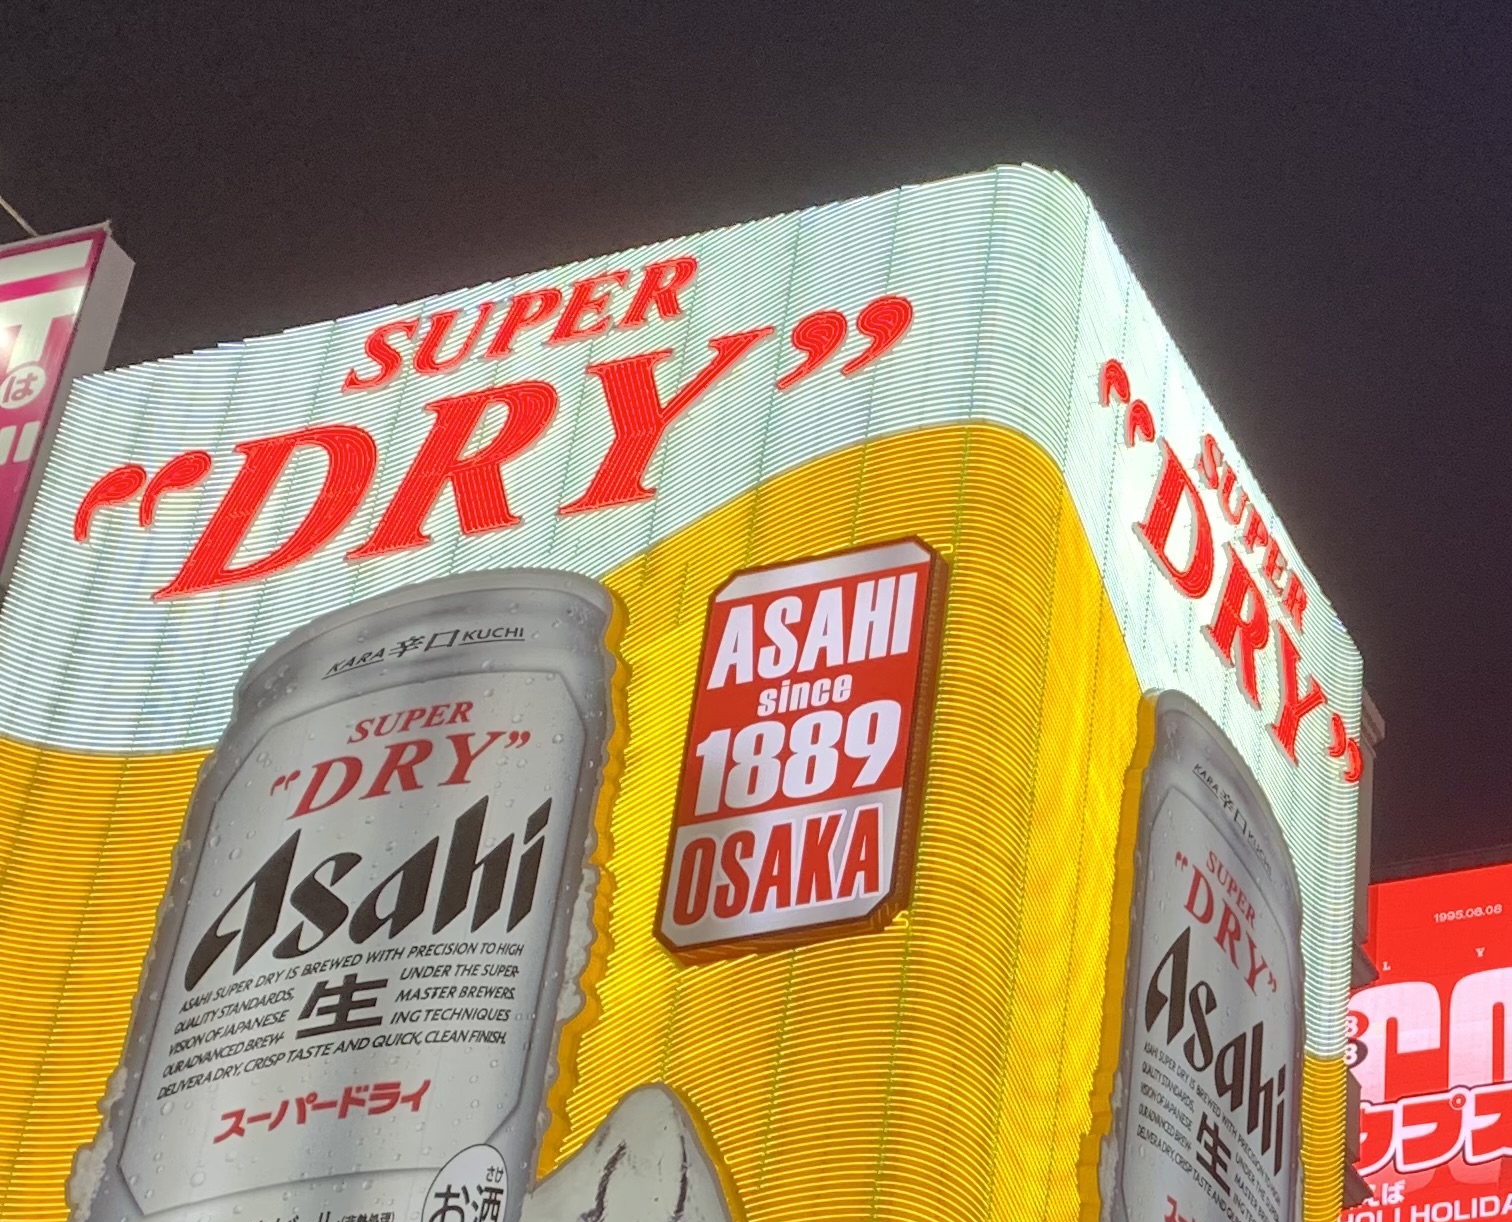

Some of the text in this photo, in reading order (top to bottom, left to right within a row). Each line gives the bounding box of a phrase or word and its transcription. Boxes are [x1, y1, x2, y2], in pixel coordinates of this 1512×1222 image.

[342, 256, 698, 394] SUPER
[1197, 433, 1308, 634] SUPER
[325, 627, 524, 675] KARA 辛口 KUCHI
[705, 572, 919, 691] ASAHI
[346, 700, 474, 744] SUPER
[757, 674, 852, 718] since
[694, 699, 902, 817] 1889
[1194, 764, 1219, 794] KARA
[183, 795, 552, 991] Asahi
[672, 803, 881, 926] OSAKA
[1206, 850, 1256, 930] SUPER
[173, 1010, 218, 1035] QUALITY
[400, 965, 452, 980] UNDER
[454, 964, 481, 977] THE
[179, 942, 524, 1014] ASAHI SUPER DRY IS BREWED WITH PRECISION TO HIGH
[295, 973, 388, 1039] 生
[163, 1059, 186, 1078] OUR
[184, 1042, 245, 1070] ADVANCED
[390, 1010, 422, 1025] ING
[423, 1008, 511, 1022] TECHNIQUES
[169, 1032, 206, 1056] VISION
[205, 1027, 224, 1043] OF
[220, 1009, 289, 1039] JAPANESE
[395, 986, 457, 1002] MASTER
[1144, 926, 1286, 1176] Asahi
[157, 1074, 203, 1100] DELIVER
[244, 1052, 286, 1072] CRISP
[287, 1042, 333, 1064] TASTE
[333, 1037, 370, 1053] AND
[425, 1030, 470, 1043] CLEAN
[213, 1079, 431, 1144] スーパードライ
[1196, 1112, 1231, 1196] 生
